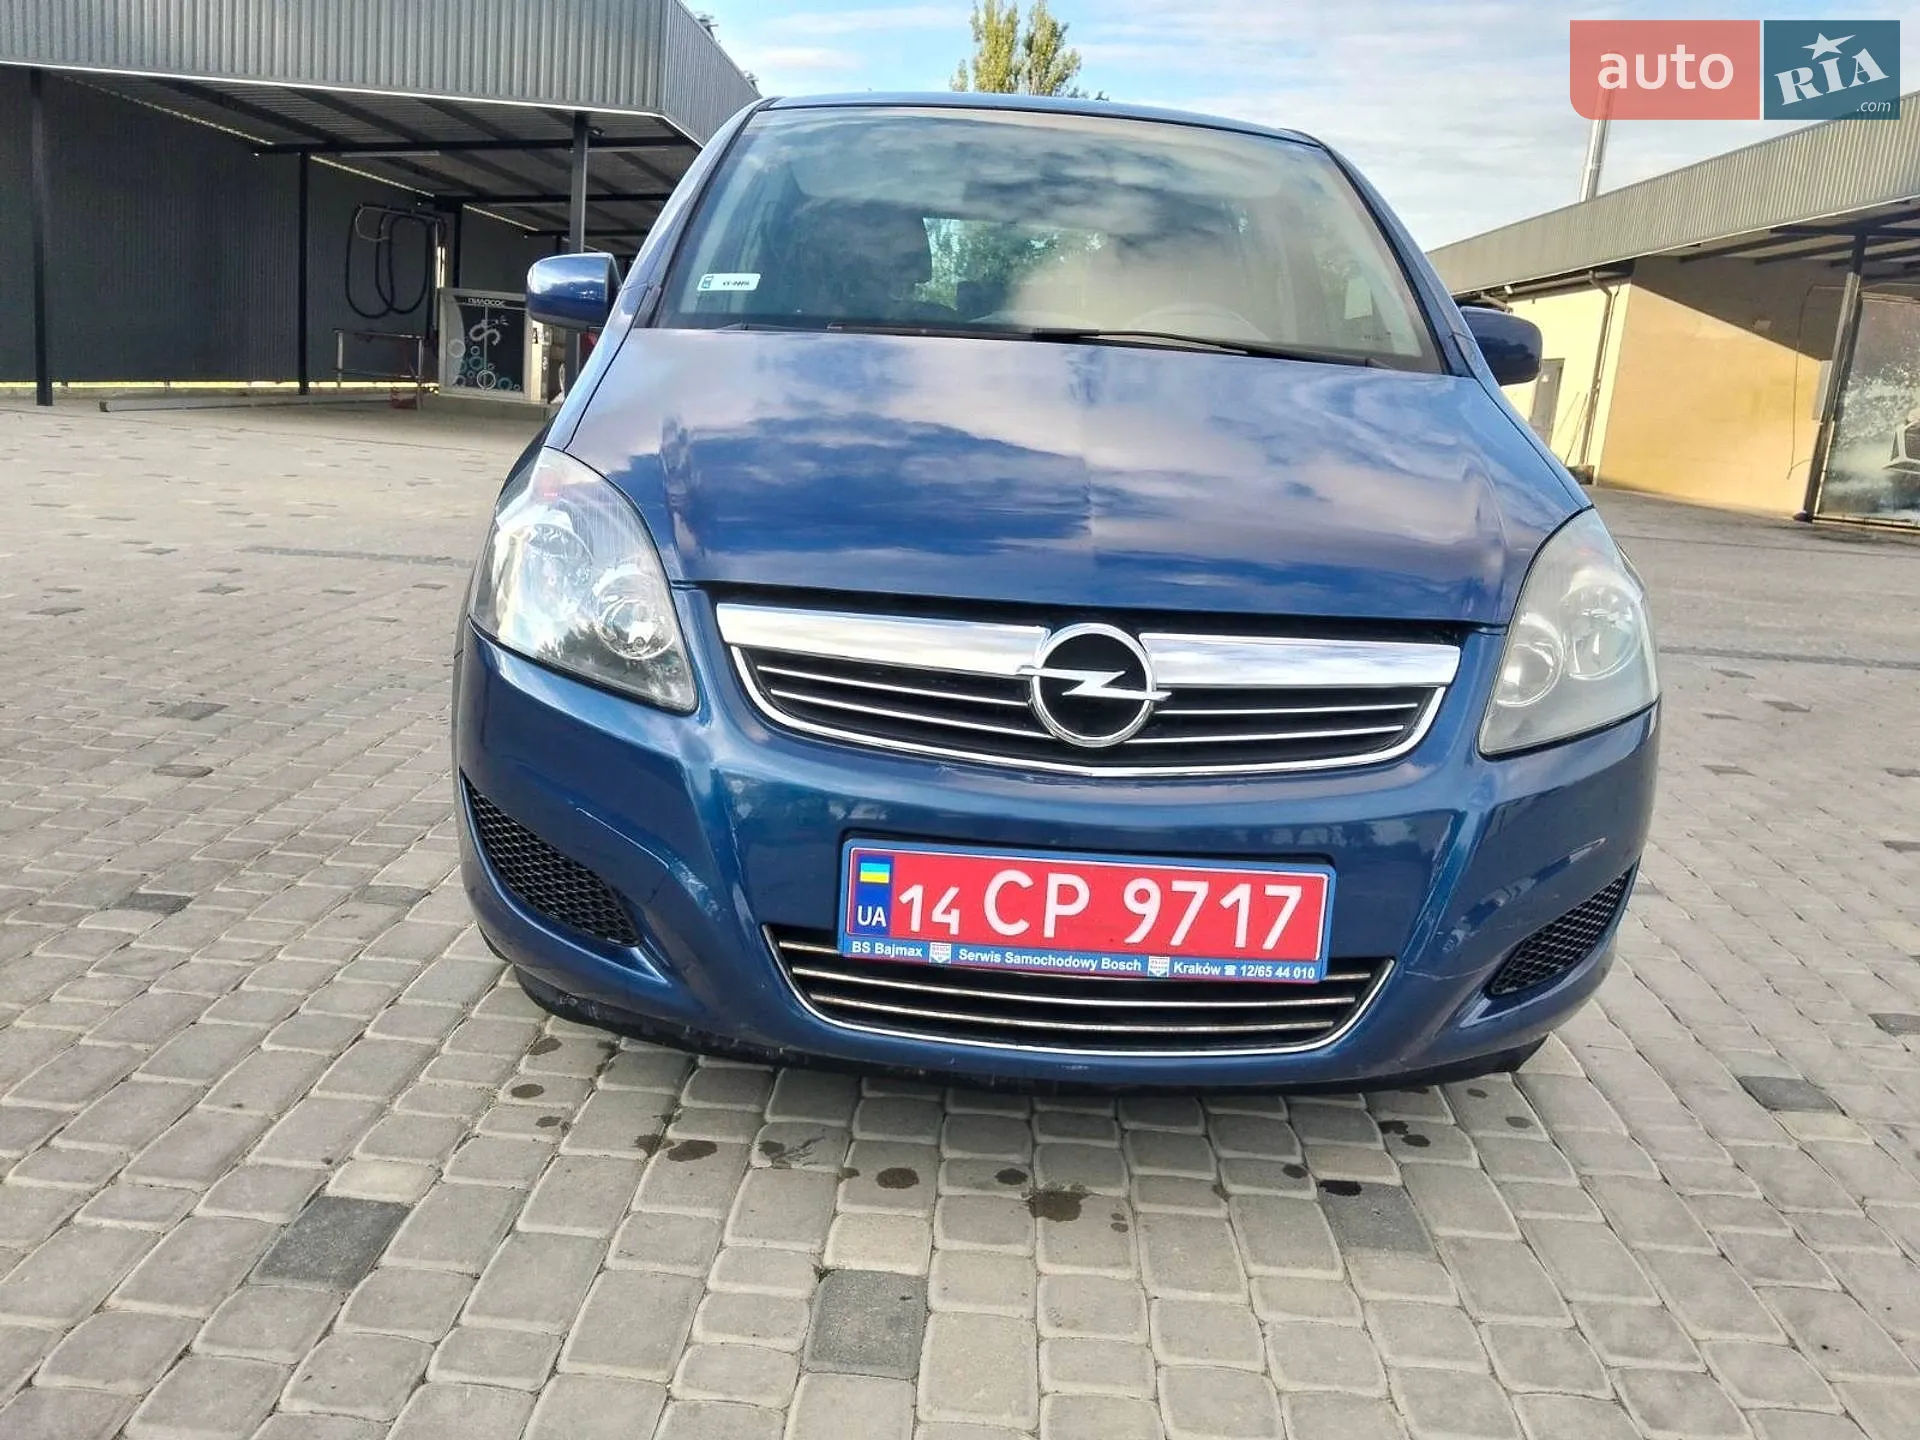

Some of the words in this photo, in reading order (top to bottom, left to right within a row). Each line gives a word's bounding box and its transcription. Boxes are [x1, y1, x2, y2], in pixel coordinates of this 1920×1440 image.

[857, 905, 887, 927] UA
[898, 884, 960, 935] 14
[983, 869, 1090, 938] CP
[1123, 877, 1303, 951] 9717
[852, 941, 869, 953] BS
[874, 943, 923, 958] Bajmax
[959, 949, 1001, 963] Serwis
[1005, 951, 1097, 971] Samochodowy
[1101, 957, 1142, 971] Bosch
[1173, 962, 1221, 976] Kraków
[1240, 965, 1272, 977] 12/65
[1275, 966, 1291, 978] 44
[1293, 967, 1315, 979] 010
